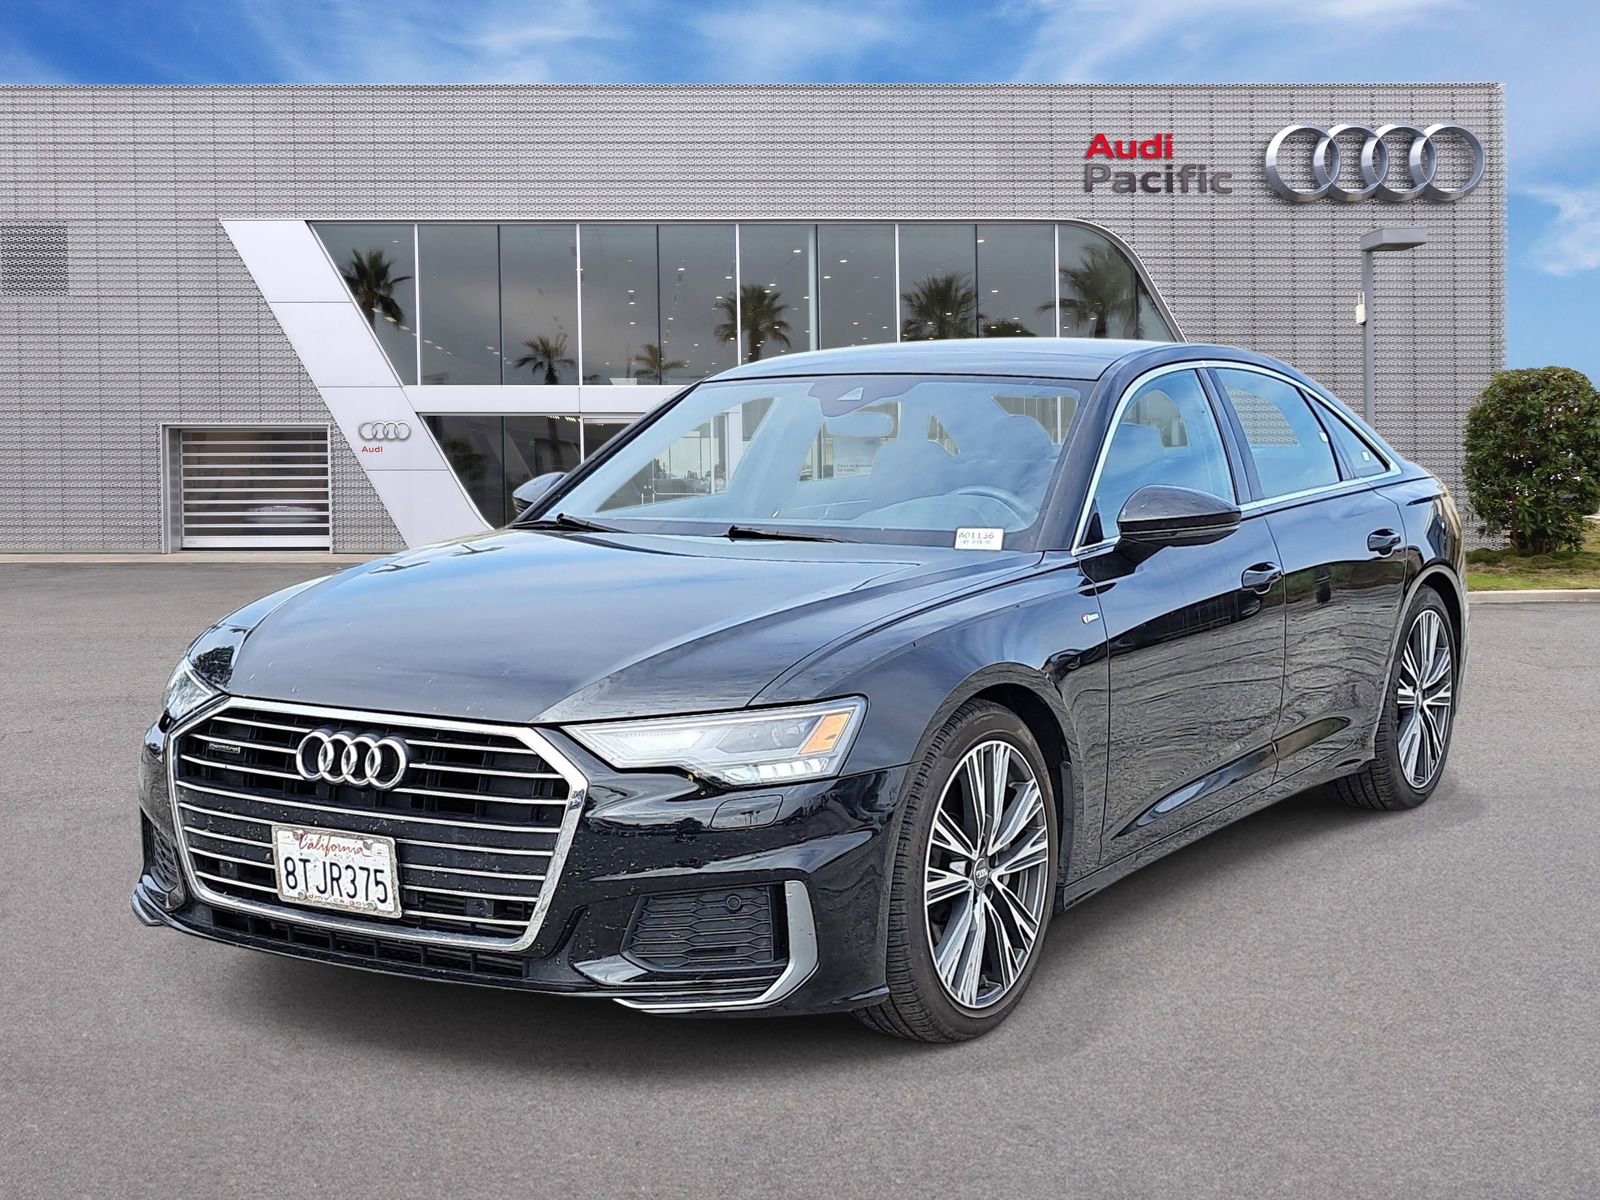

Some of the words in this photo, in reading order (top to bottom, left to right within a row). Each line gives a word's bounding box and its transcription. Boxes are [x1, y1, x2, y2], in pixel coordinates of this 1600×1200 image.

[1085, 133, 1174, 160] Audi
[1084, 163, 1233, 194] Pacific
[361, 445, 384, 453] Audi
[298, 831, 373, 858] California
[283, 856, 389, 904] 8TJR375
